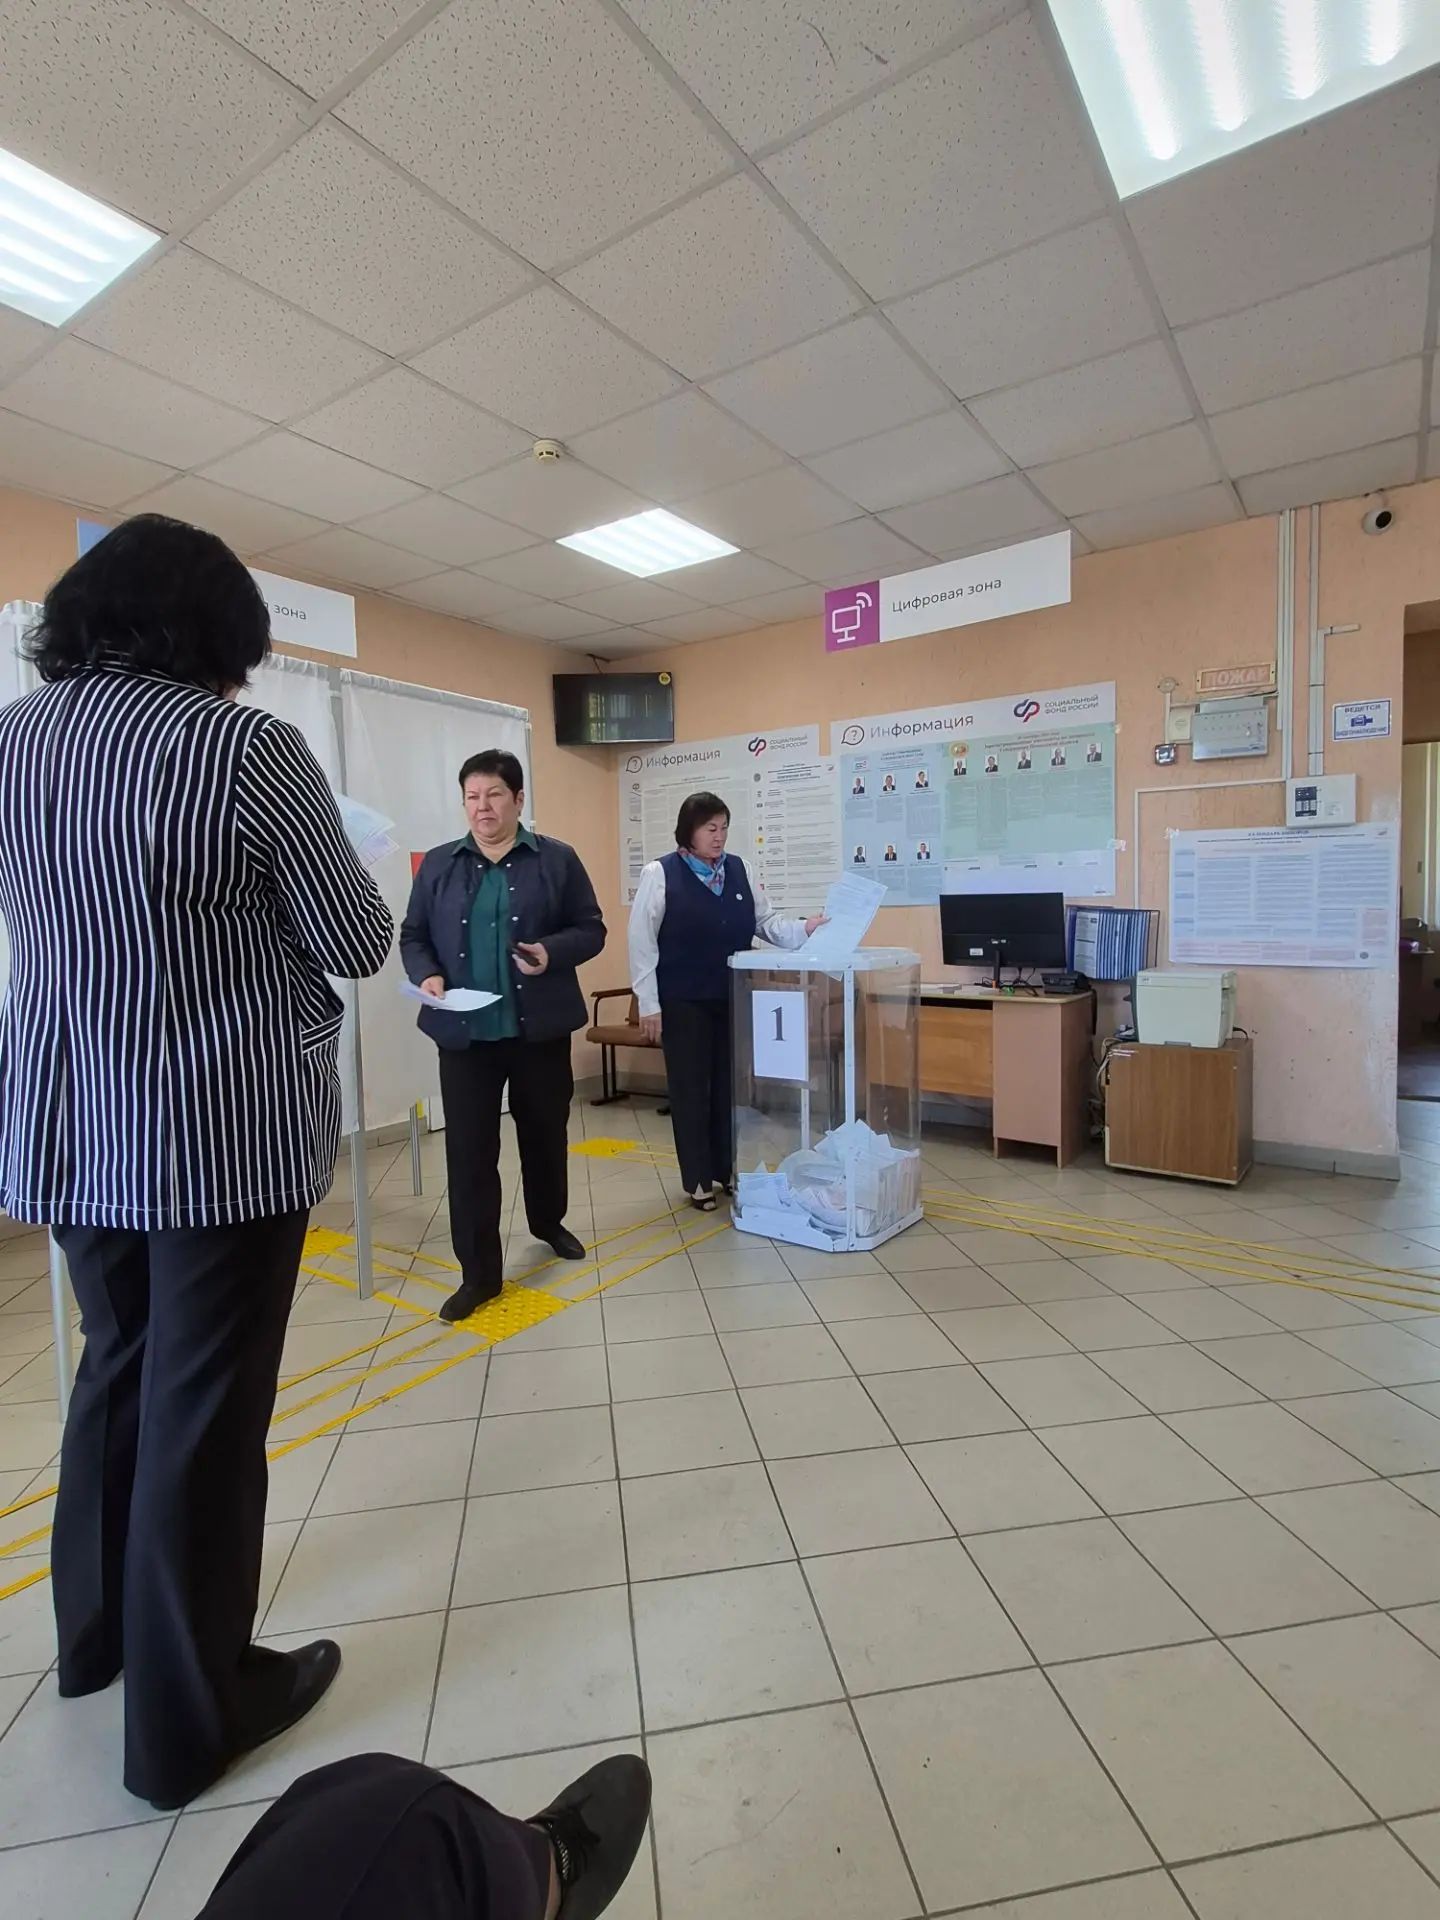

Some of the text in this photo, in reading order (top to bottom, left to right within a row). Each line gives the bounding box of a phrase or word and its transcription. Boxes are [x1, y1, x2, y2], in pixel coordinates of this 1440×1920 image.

[892, 579, 1002, 613] Цифровая зона
[273, 604, 307, 620] зона
[1045, 694, 1099, 708] СОЦИАЛЬНЫЙ
[1045, 702, 1099, 714] ФОНД РОССИИ
[1344, 704, 1381, 713] ВЕДЕТСЯ
[870, 715, 974, 738] Информация
[646, 750, 720, 769] Информация
[770, 1006, 787, 1042] 1
